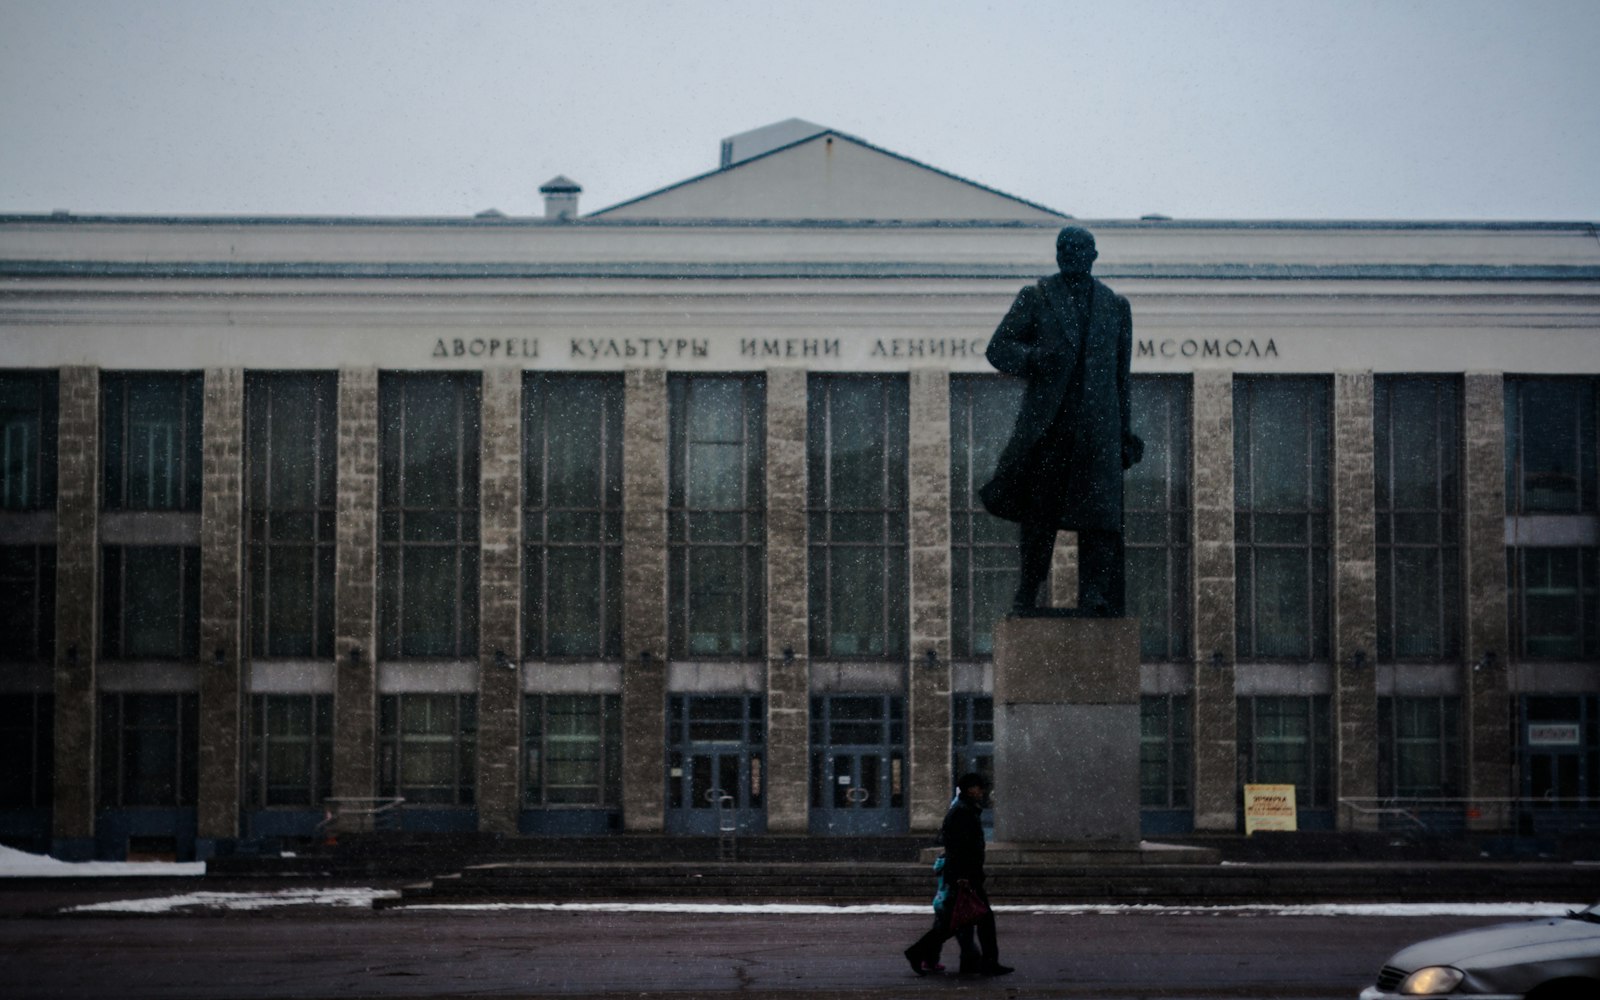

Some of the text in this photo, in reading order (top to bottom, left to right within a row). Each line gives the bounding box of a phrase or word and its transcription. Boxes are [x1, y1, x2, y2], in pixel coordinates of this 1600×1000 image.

[432, 337, 1278, 359] ДВОРЕЦ КУЛЬТУРЫ ИМЕНИ ЛЕНИНС МСОМОЛА
